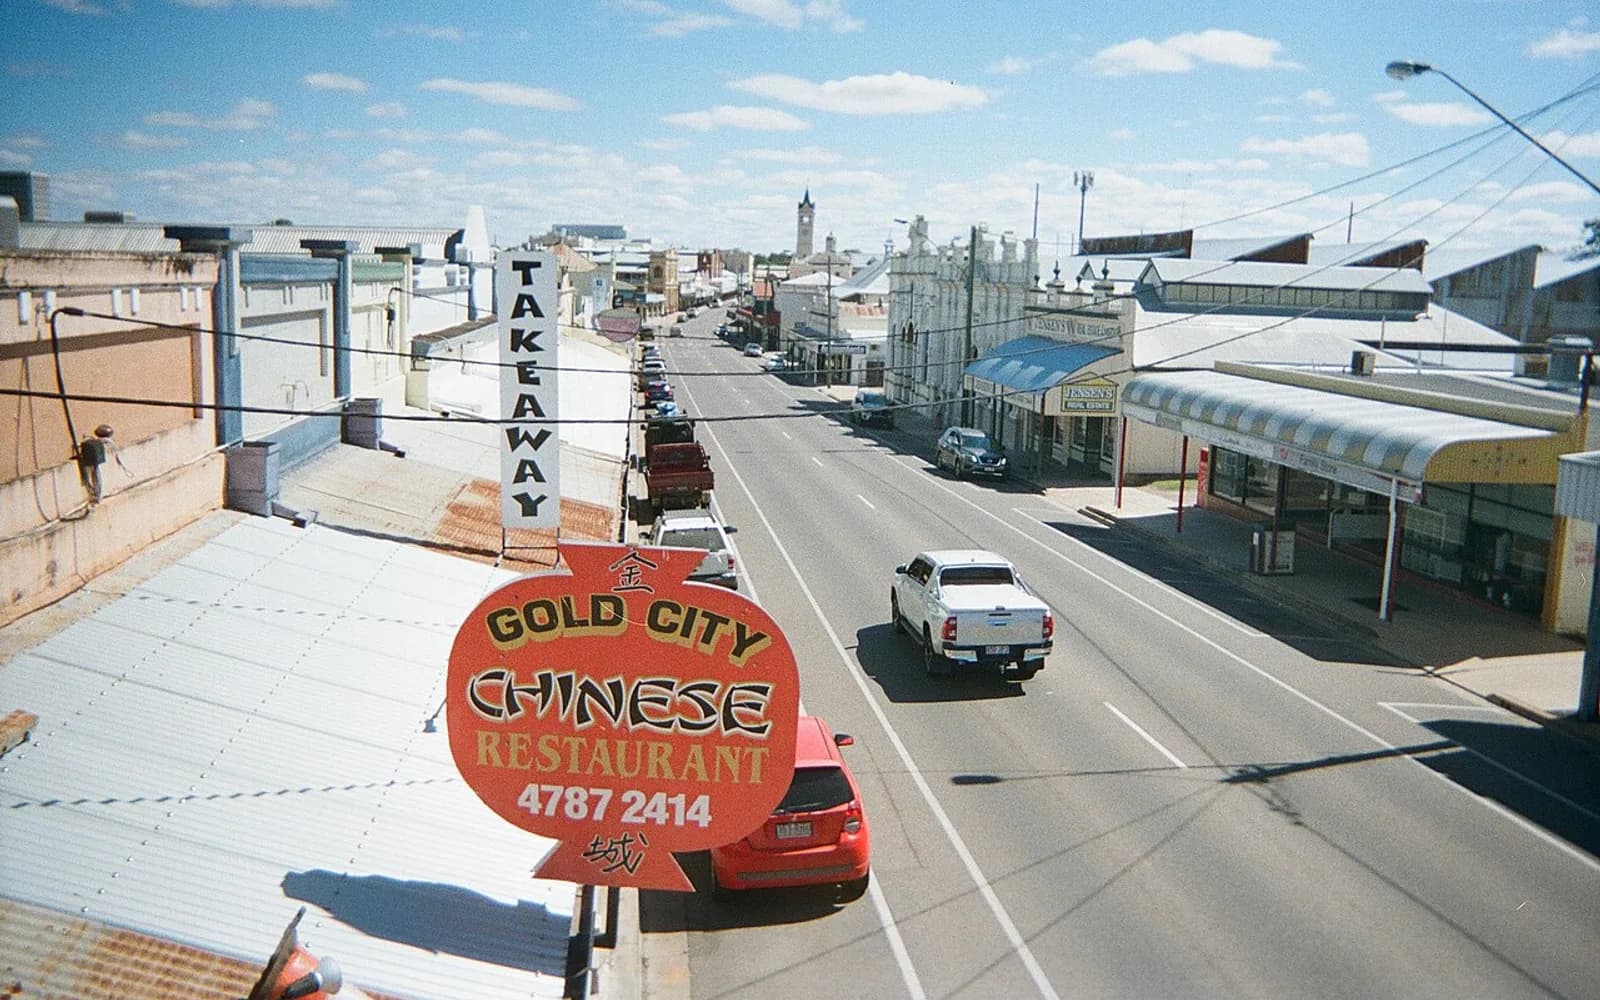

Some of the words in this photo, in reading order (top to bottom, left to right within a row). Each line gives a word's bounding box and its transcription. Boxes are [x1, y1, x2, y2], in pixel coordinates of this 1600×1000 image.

[505, 260, 552, 517] TAKEAWAY
[1066, 387, 1113, 399] JENSEN'S
[609, 551, 658, 593] 金
[486, 593, 628, 649] GOLD
[646, 599, 773, 668] CITY
[467, 668, 773, 738] CHINESE
[475, 729, 769, 784] RESTAURANT
[517, 783, 613, 822] 4787
[621, 790, 712, 827] 2414
[582, 831, 649, 875] 城
